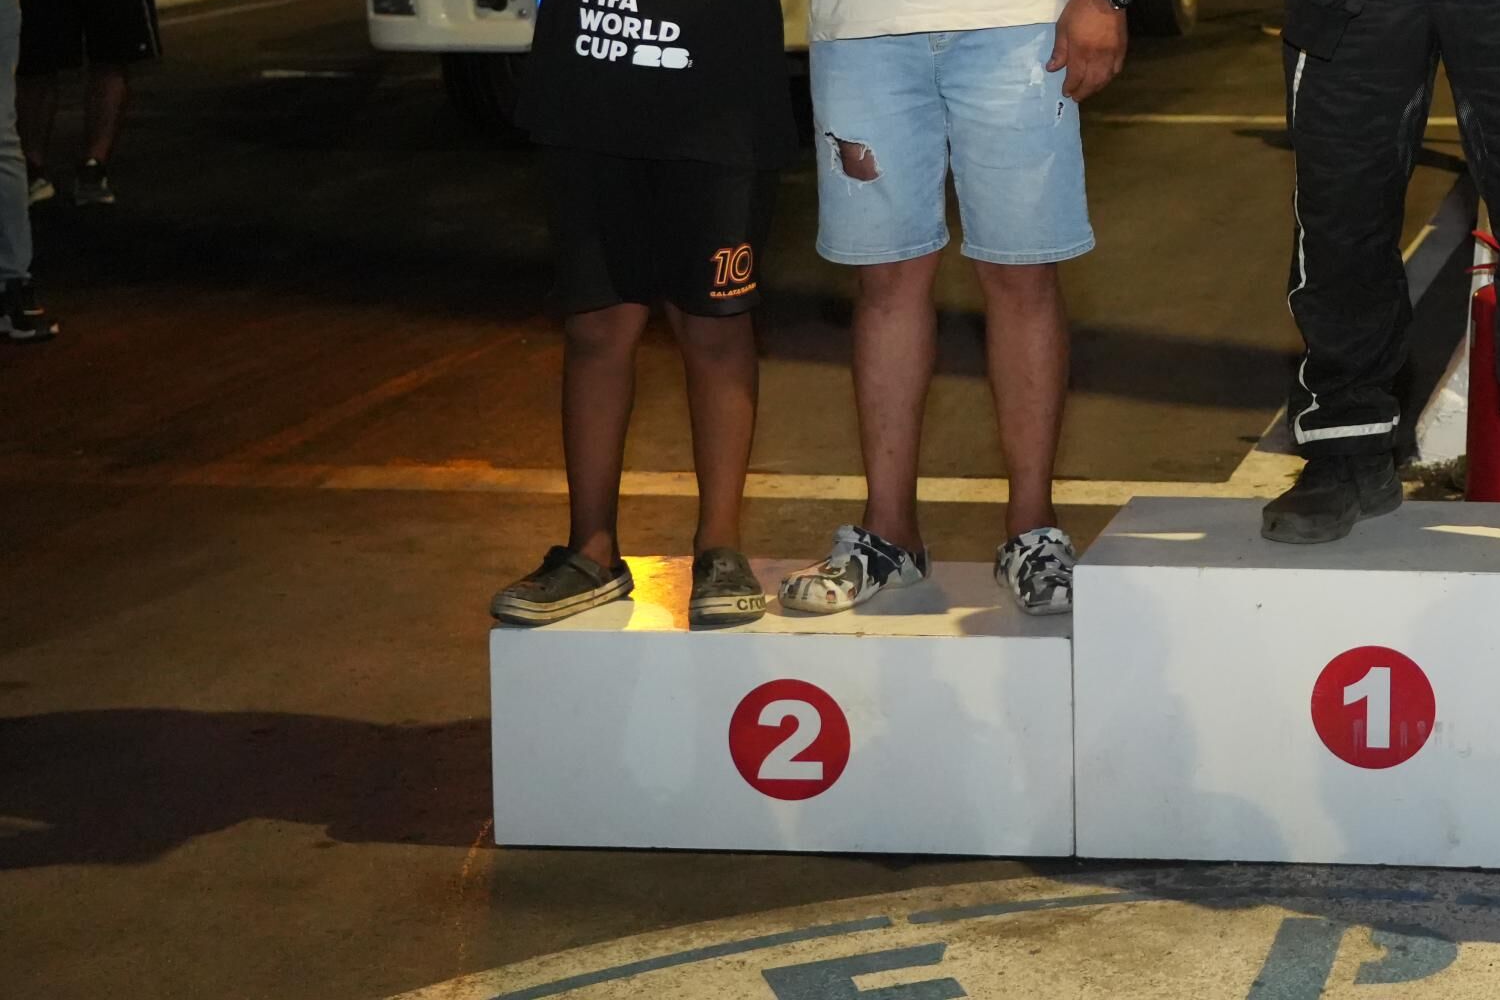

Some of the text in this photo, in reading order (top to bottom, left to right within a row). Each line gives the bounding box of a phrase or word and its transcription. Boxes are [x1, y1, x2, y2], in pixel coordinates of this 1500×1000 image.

[579, 8, 680, 42] WORLD
[575, 34, 628, 62] CUP
[711, 244, 754, 287] 10
[1343, 666, 1391, 749] 1
[757, 699, 823, 780] 2
